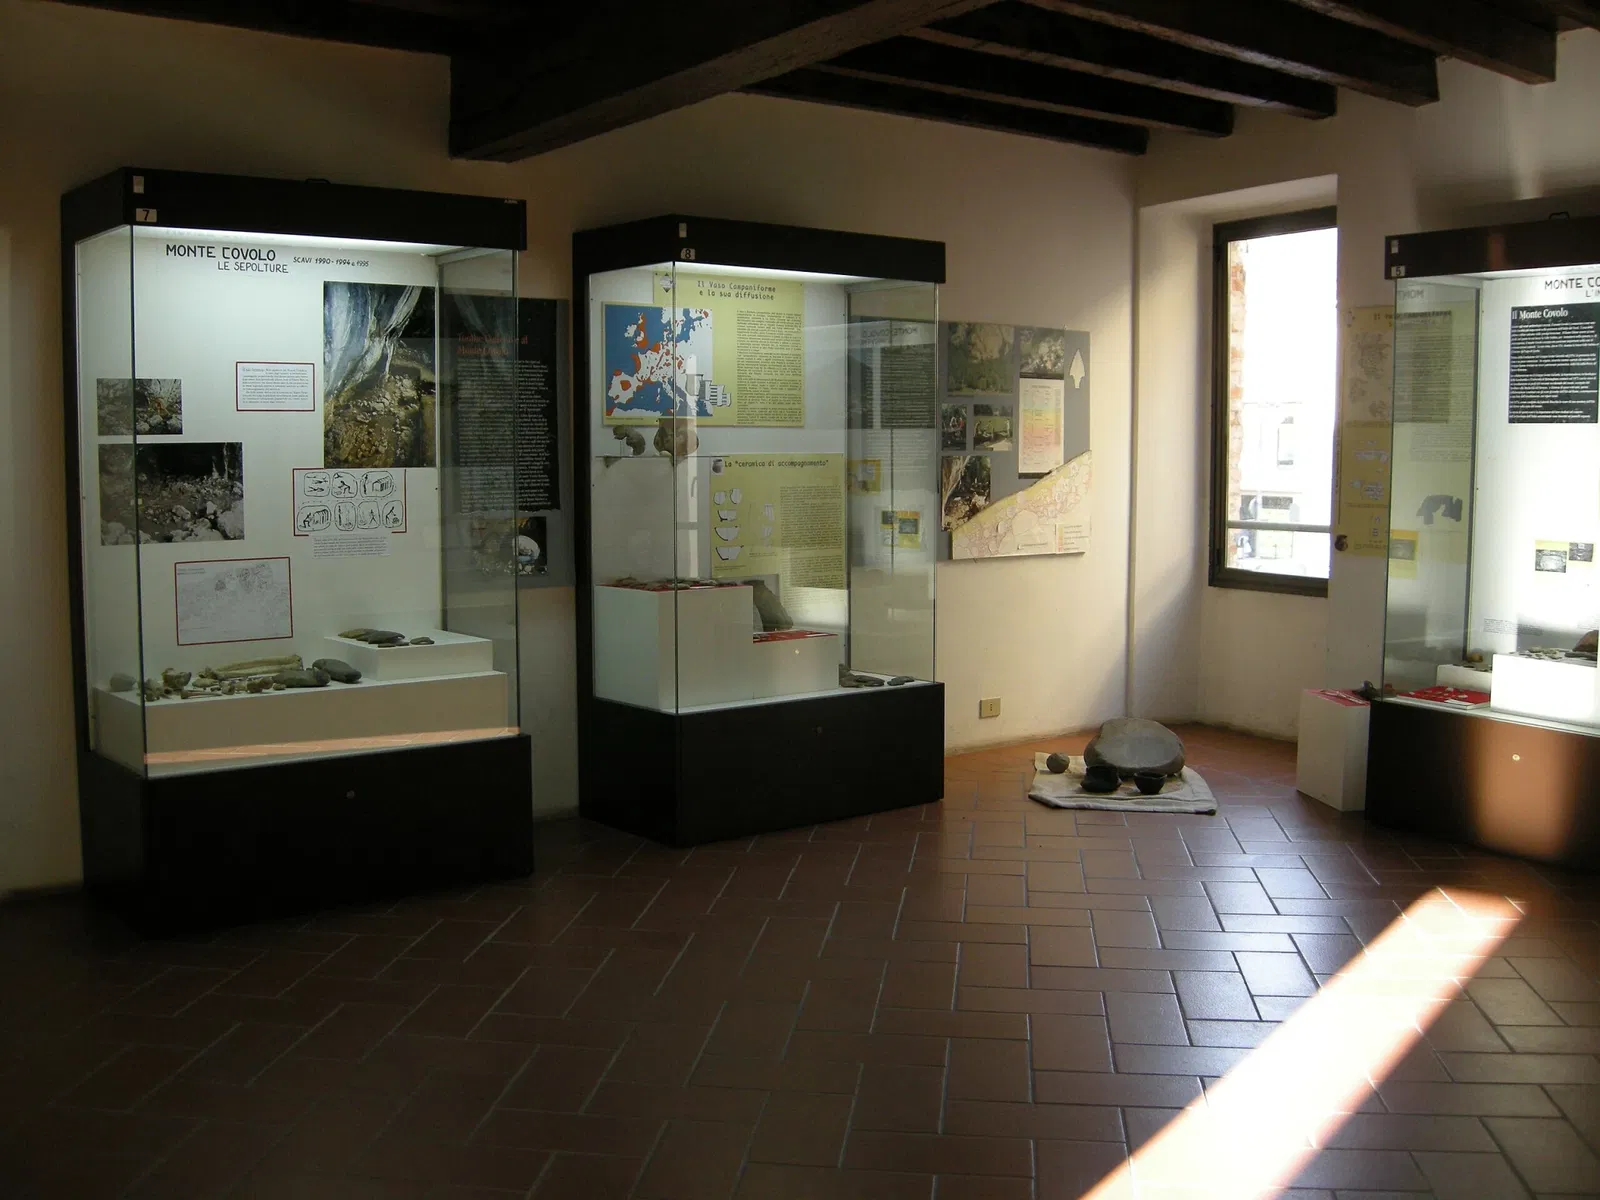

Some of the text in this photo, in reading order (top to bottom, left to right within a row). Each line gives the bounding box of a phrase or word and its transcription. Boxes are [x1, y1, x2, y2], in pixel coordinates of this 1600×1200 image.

[142, 209, 150, 221] 7
[165, 244, 276, 262] MONTE COVOLO
[685, 248, 692, 259] 8
[293, 256, 313, 264] SCAVI
[217, 261, 289, 273] LE SEPOLTURE
[1395, 266, 1402, 277] 5
[697, 280, 776, 293] Il Vaso Campaniforme
[1544, 277, 1583, 290] MONTE
[735, 292, 775, 300] diffusione
[1512, 307, 1569, 321] Il Monte Covolo
[724, 460, 732, 468] La
